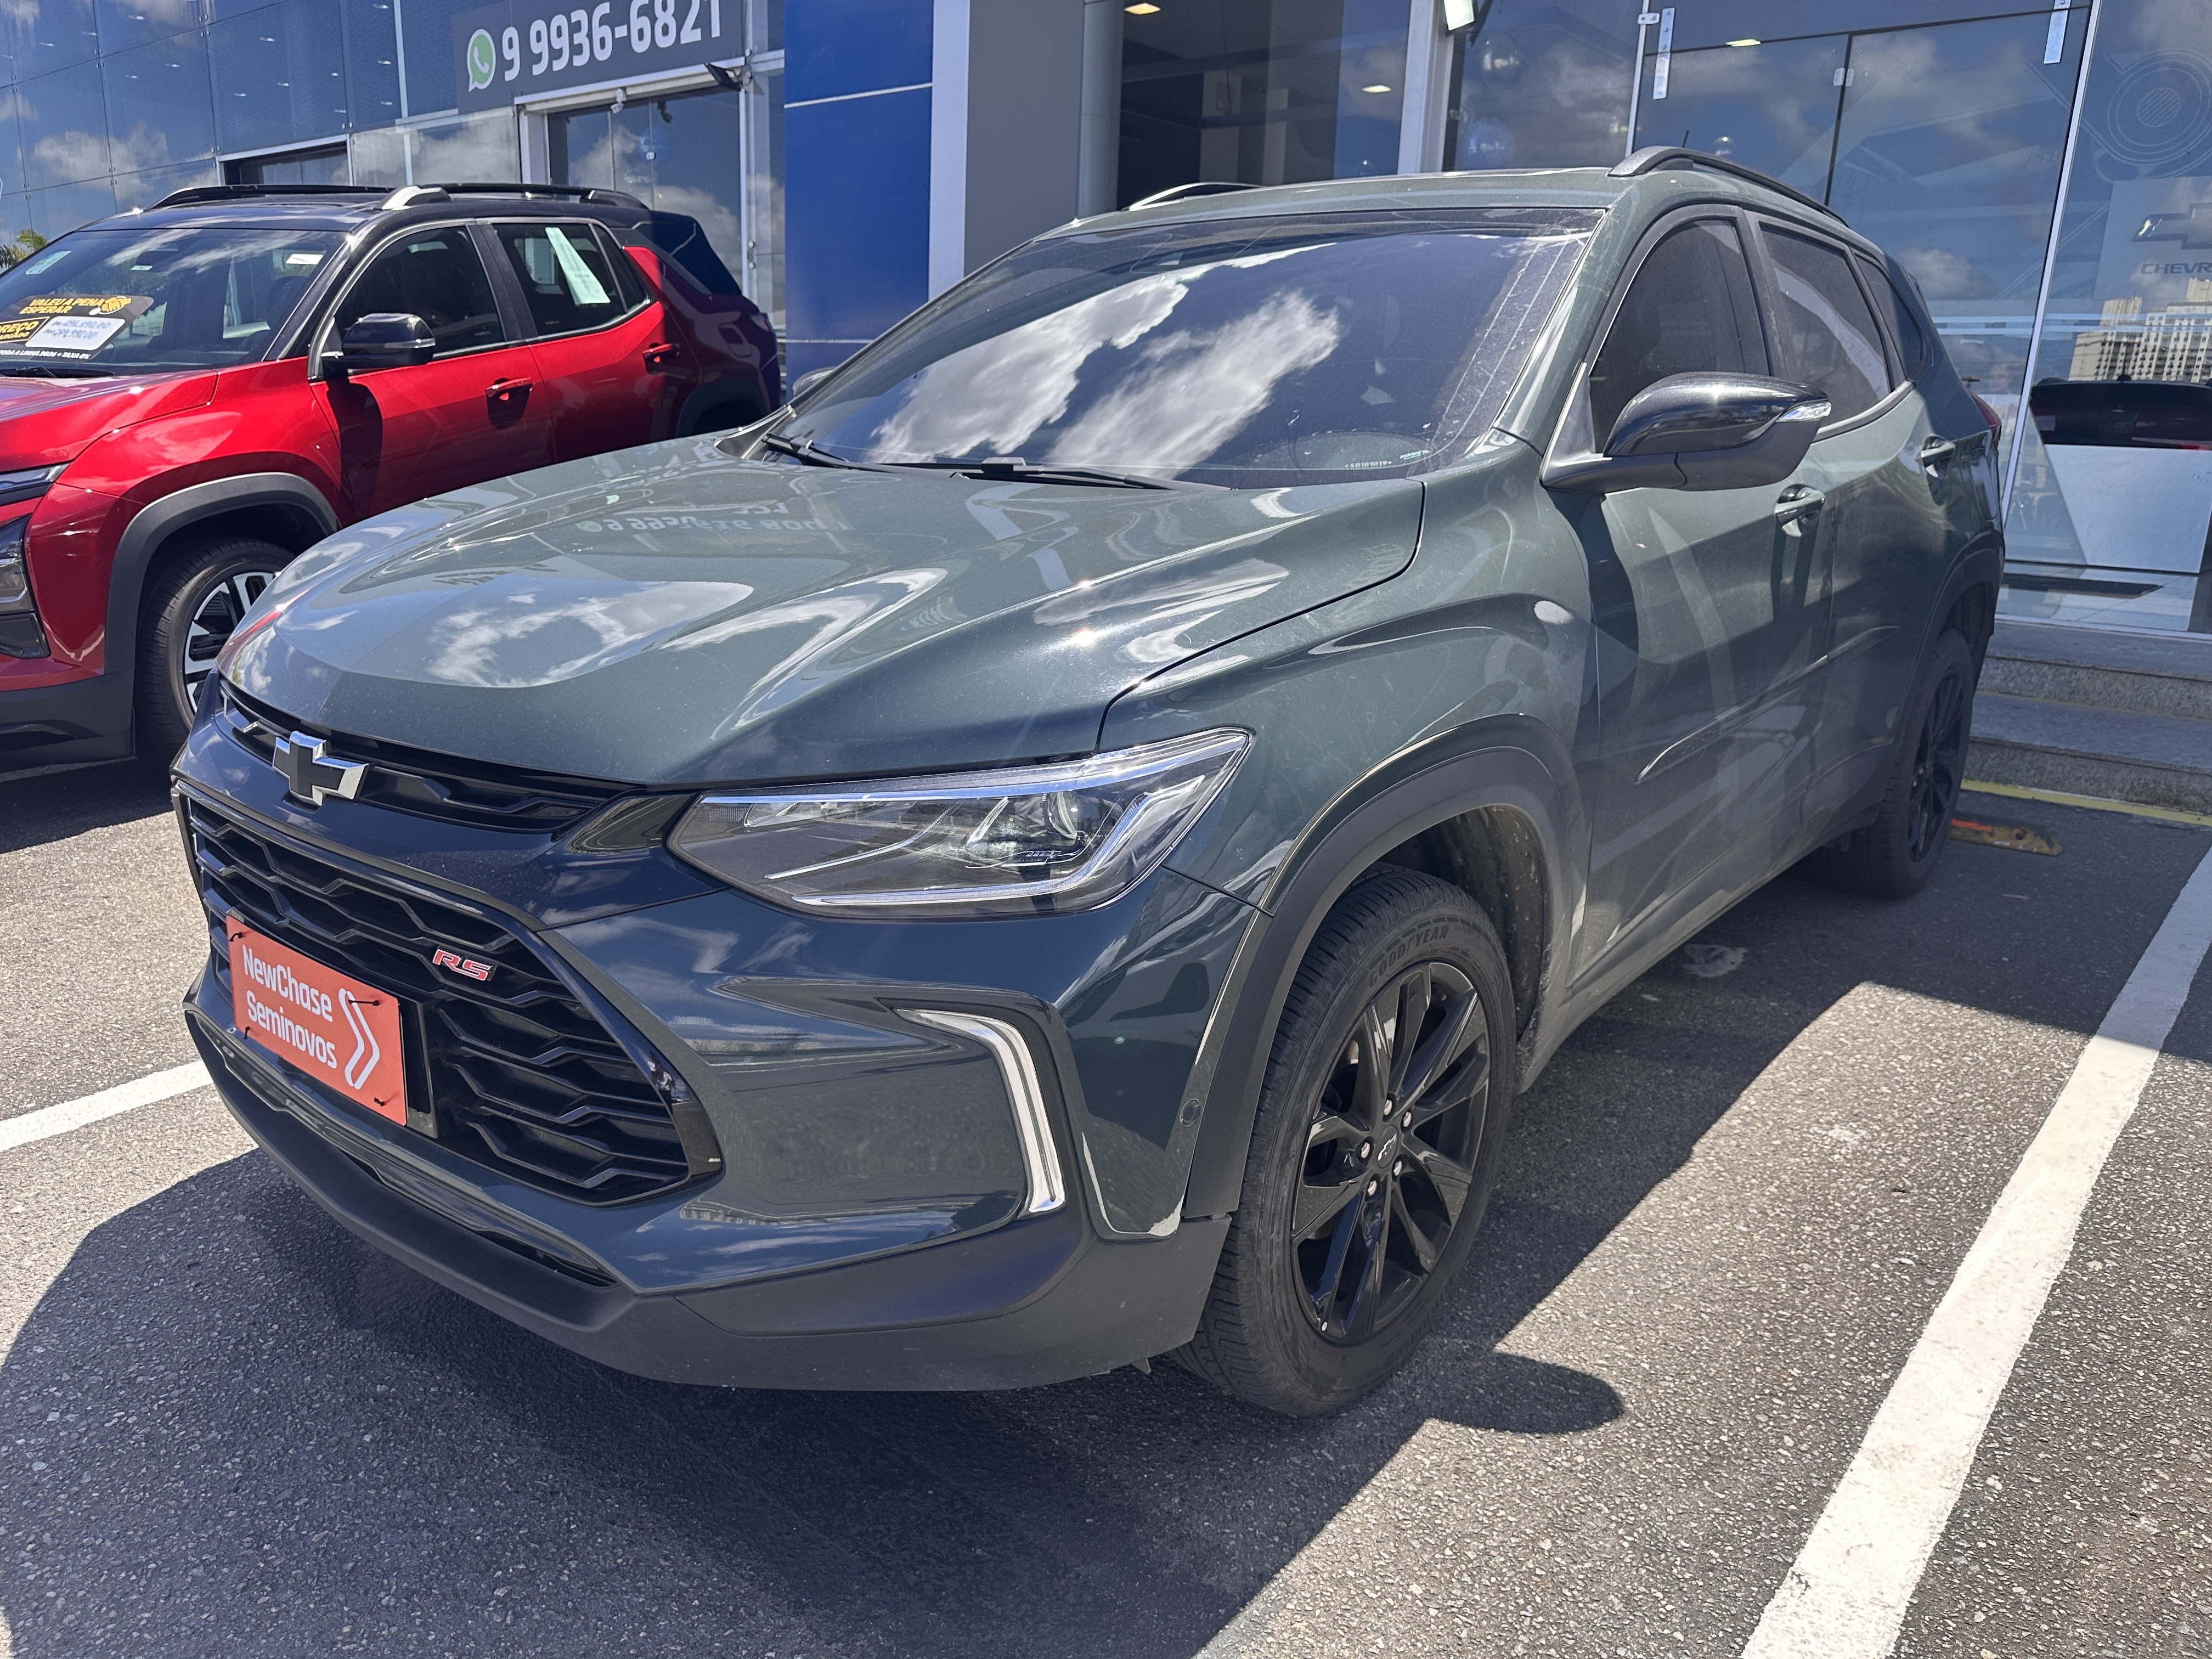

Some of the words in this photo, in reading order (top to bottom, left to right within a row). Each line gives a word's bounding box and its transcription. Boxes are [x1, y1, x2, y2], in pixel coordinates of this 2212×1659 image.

[502, 26, 521, 81] 9
[529, 0, 720, 76] 9936-6821
[19, 306, 72, 314] ESPERAR
[242, 944, 333, 1023] NewChase
[433, 949, 493, 981] RS
[246, 990, 337, 1069] Seminovos
